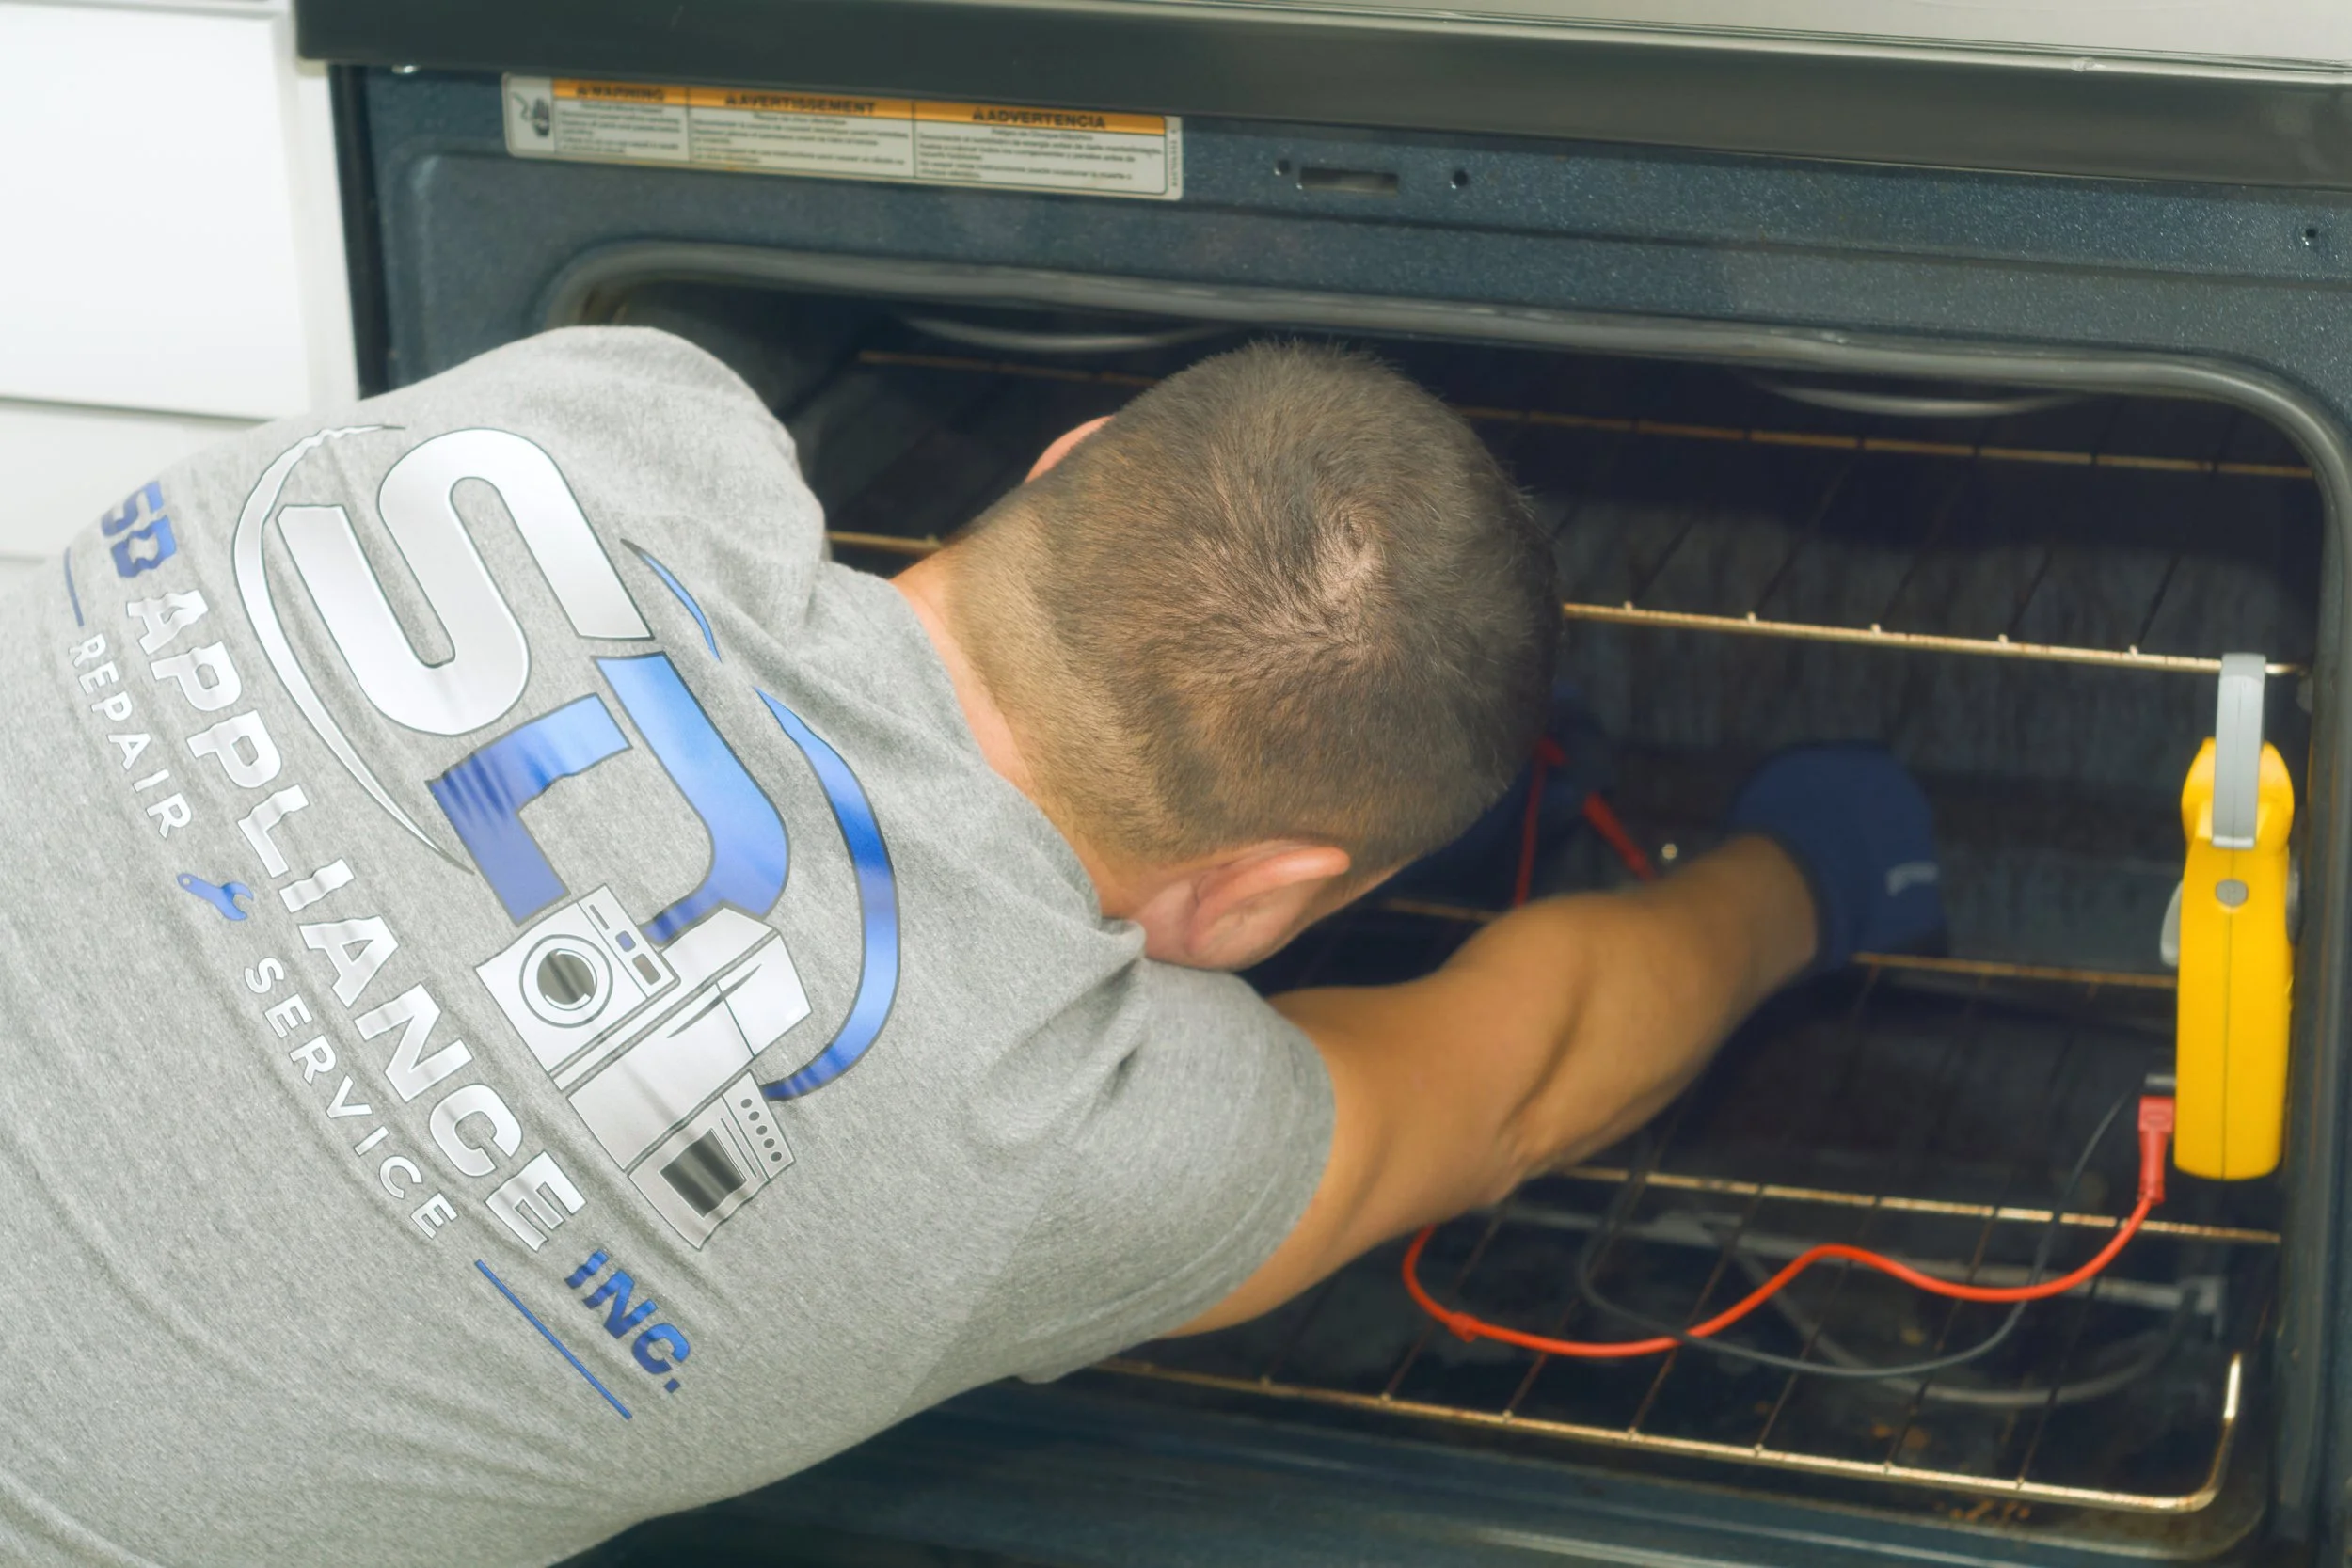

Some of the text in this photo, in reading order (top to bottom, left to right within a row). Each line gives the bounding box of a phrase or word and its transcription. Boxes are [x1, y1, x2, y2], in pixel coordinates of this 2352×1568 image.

[592, 86, 664, 100] WARNING
[740, 93, 875, 114] AVERTISSEMENT
[987, 108, 1104, 129] ADVERTENCIA
[68, 633, 458, 1240] REPAIR SERVICE
[100, 480, 691, 1394] SD APPLIANCE INC.
